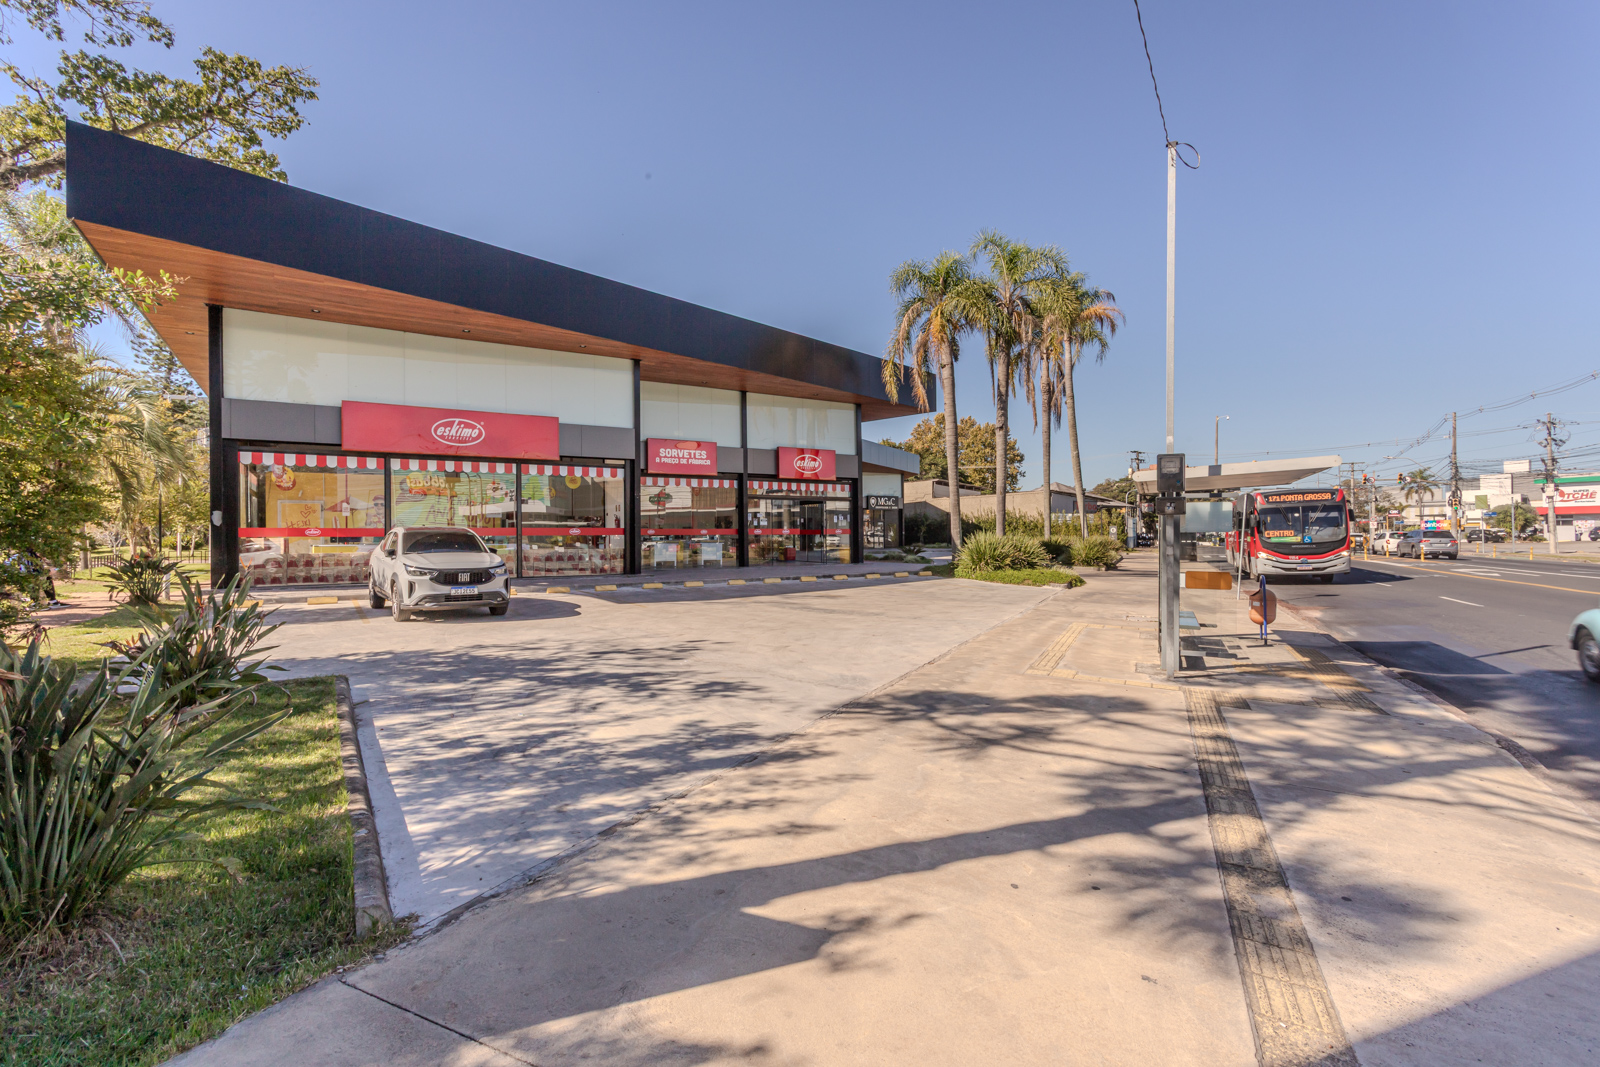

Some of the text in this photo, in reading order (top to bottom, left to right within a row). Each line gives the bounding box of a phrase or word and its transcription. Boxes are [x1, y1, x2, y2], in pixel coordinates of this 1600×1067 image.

[659, 448, 707, 459] SORVETES
[688, 458, 711, 466] FÁBRICA
[1280, 494, 1303, 502] PONTA
[1303, 493, 1332, 501] GROSSA
[1565, 490, 1598, 499] TCHÊ
[1265, 530, 1294, 538] CENTRO
[458, 572, 471, 582] FIAT
